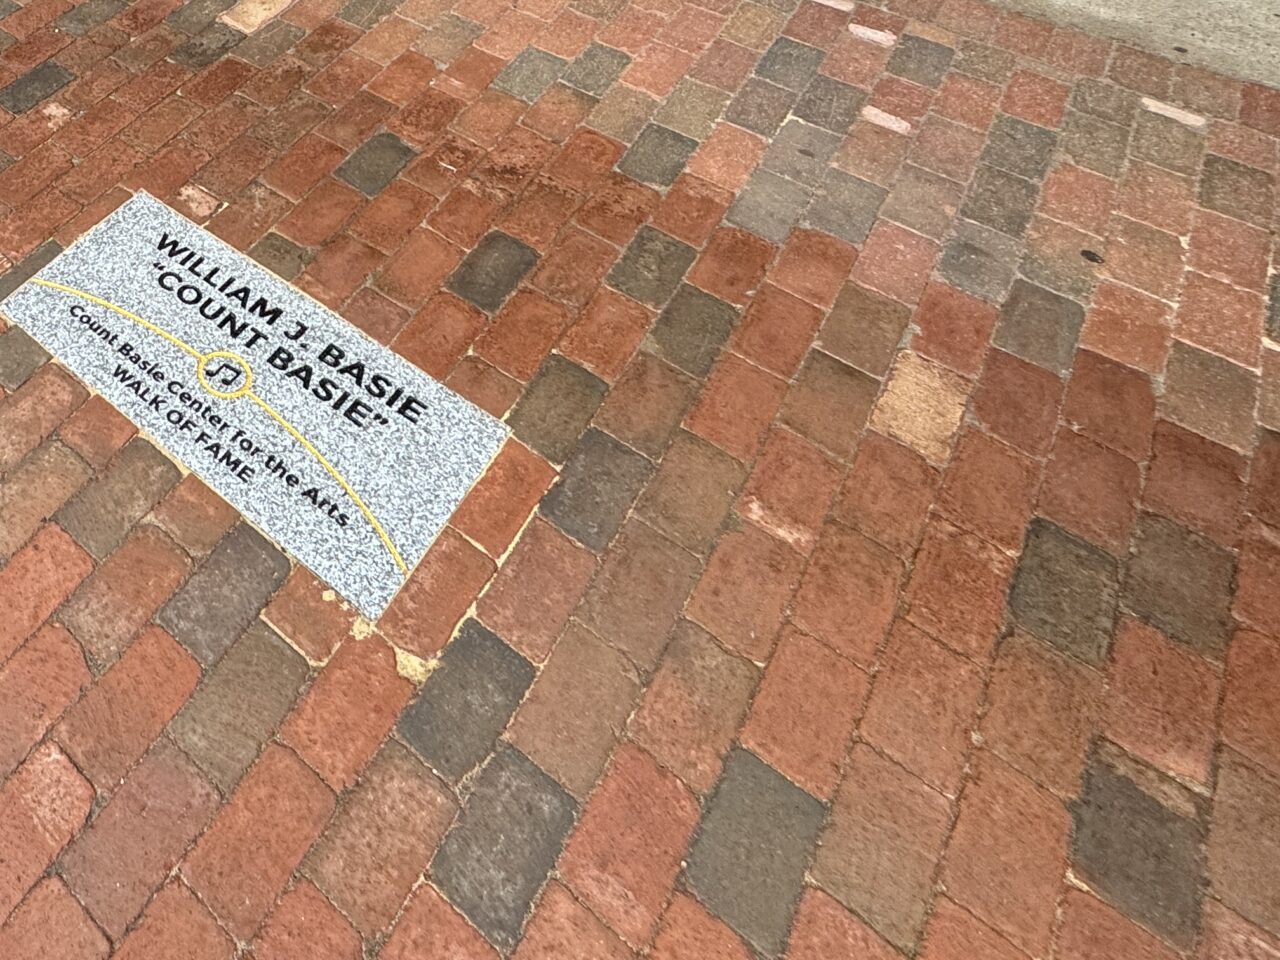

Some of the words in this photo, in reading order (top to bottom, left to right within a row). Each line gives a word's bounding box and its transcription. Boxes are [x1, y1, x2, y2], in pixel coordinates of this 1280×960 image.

[70, 304, 122, 346] Count
[118, 342, 166, 382] Basie
[167, 380, 229, 431] Center
[233, 429, 264, 457] for
[265, 455, 300, 487] the
[301, 487, 350, 527] Arts
[153, 262, 269, 350] “COUNT
[267, 346, 389, 427] BASIE”
[156, 233, 284, 326] WILLIAM
[284, 321, 310, 349] J.
[318, 343, 429, 424] BASIE
[112, 364, 168, 412] WALK
[166, 409, 197, 433] OF
[194, 431, 256, 484] FAME
